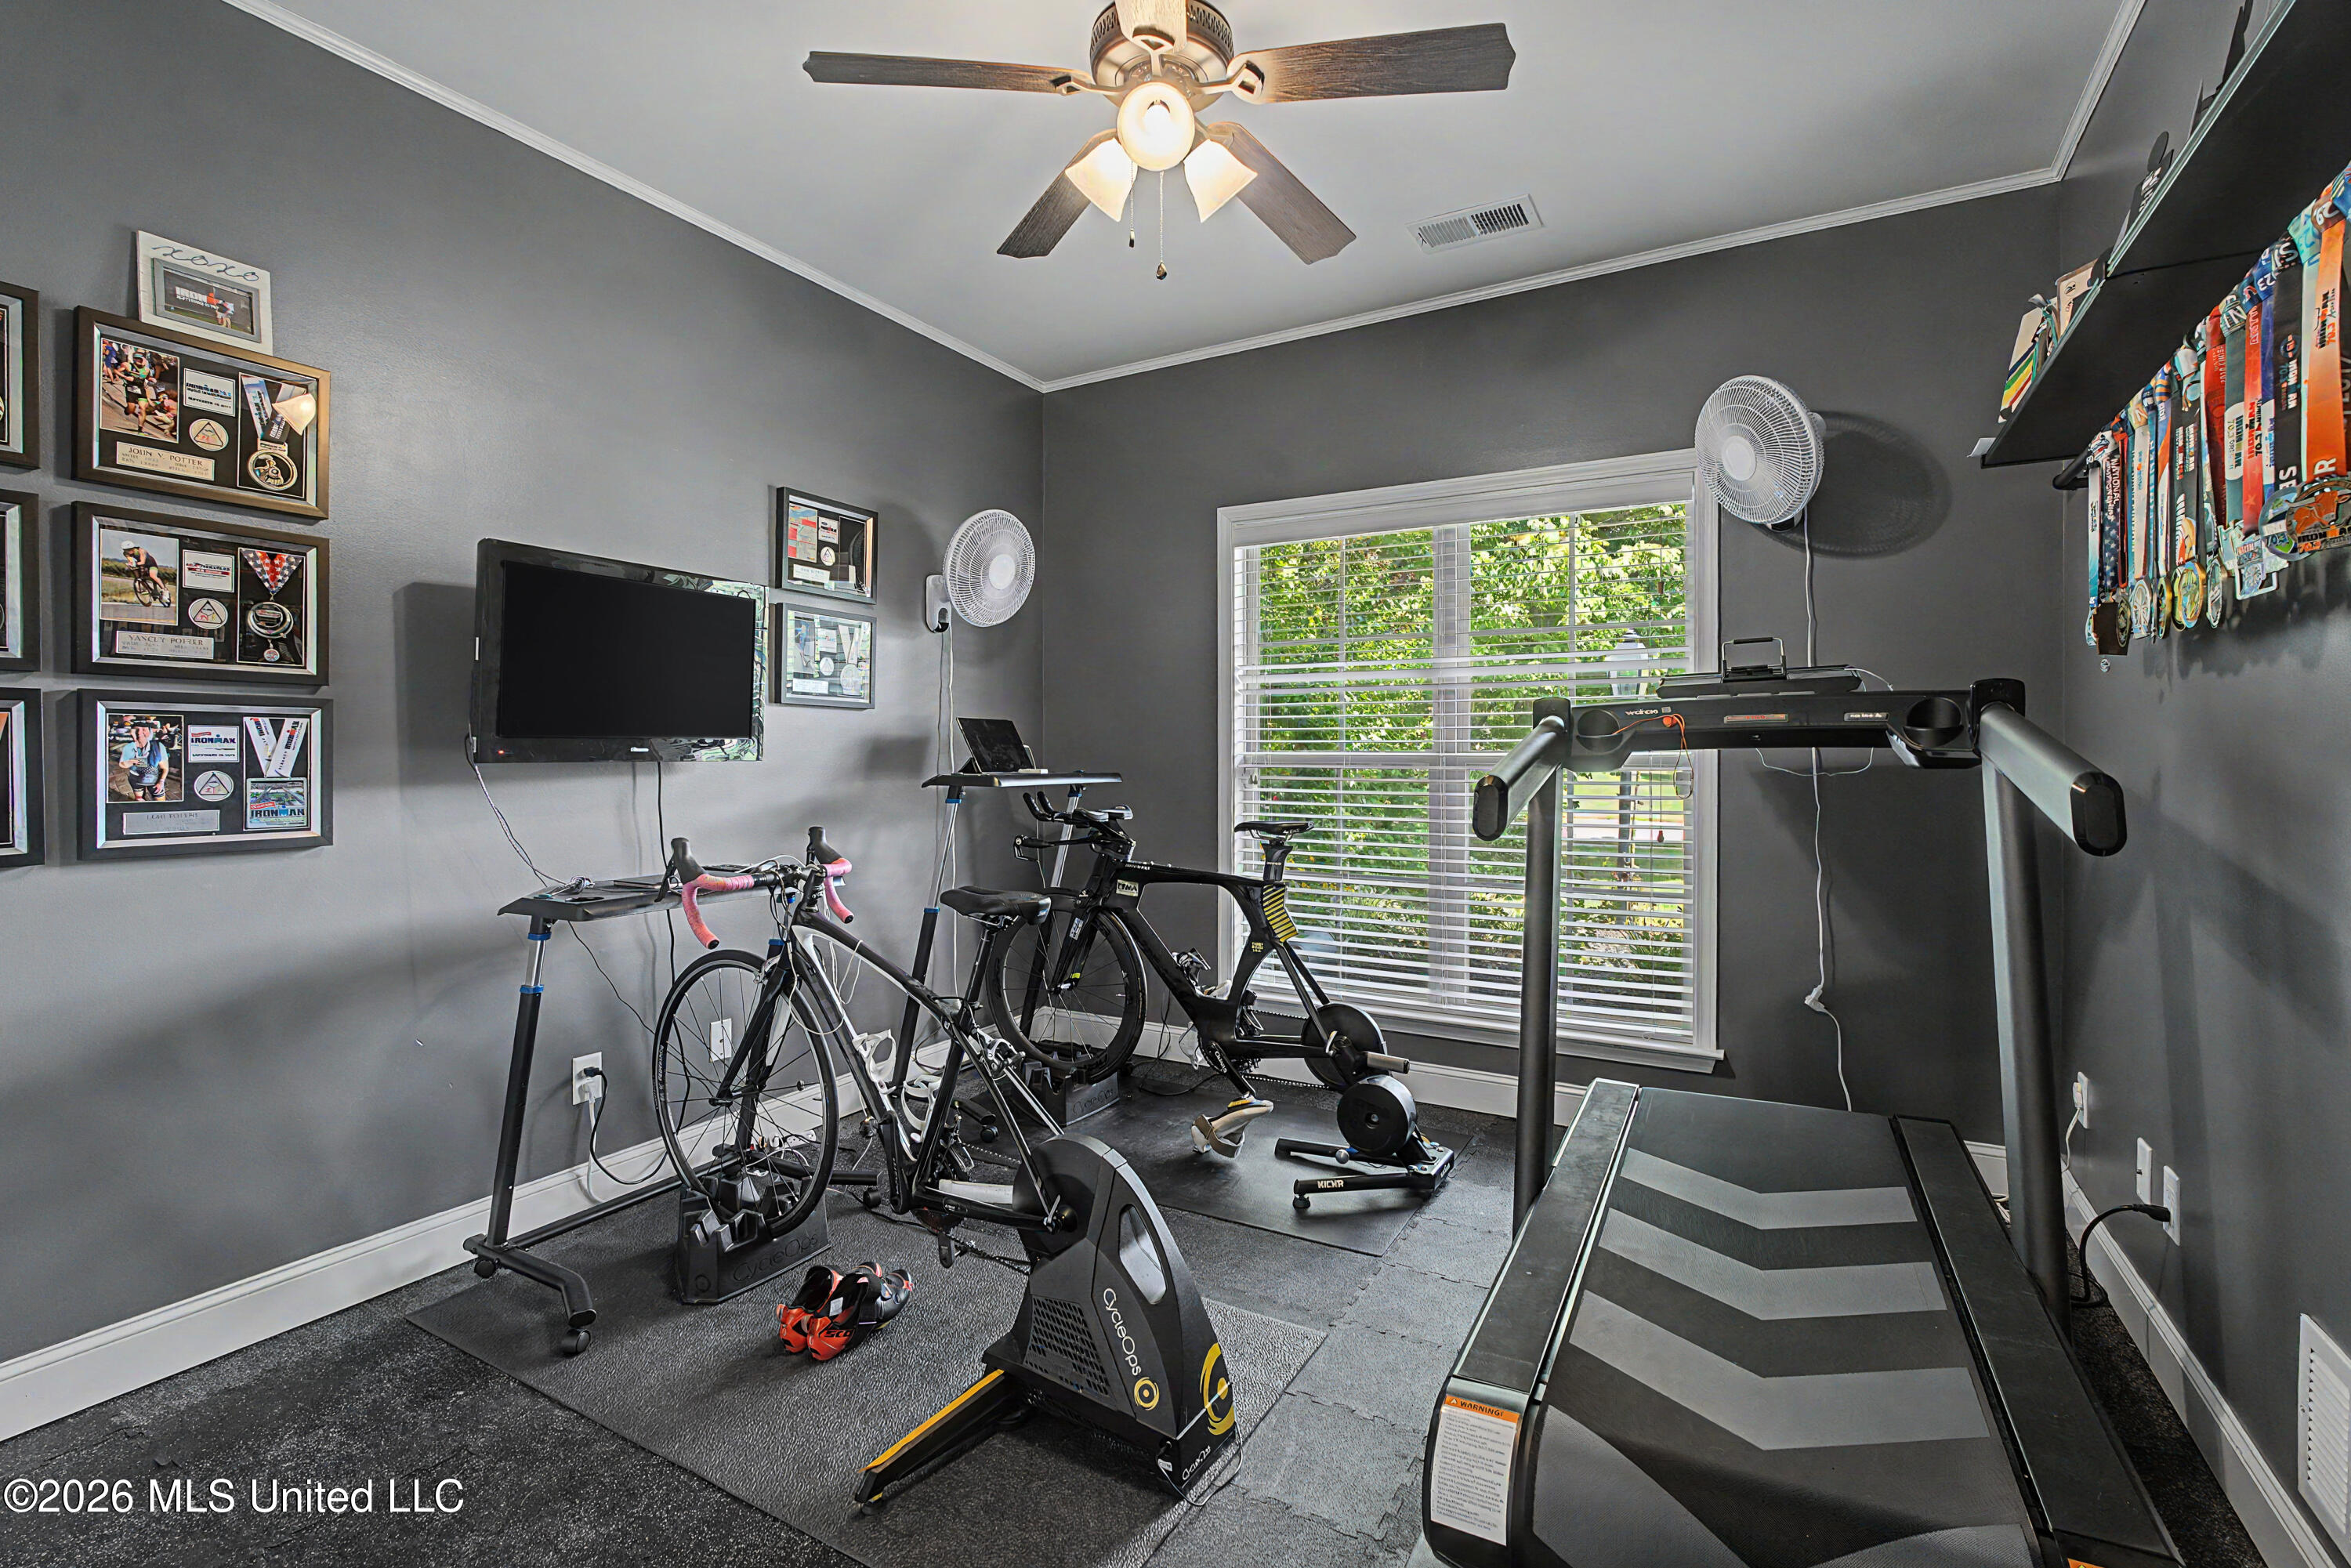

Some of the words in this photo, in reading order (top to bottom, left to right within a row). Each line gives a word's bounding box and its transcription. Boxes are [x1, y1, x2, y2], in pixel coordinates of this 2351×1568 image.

[169, 454, 204, 466] POTTER
[2110, 458, 2121, 505] NATIONAL
[190, 734, 236, 744] IRONMAN
[251, 806, 305, 817] IRONMAN
[1317, 1179, 1344, 1189] KICKR
[1103, 1287, 1142, 1376] CycleOps
[1460, 1400, 1504, 1417] WARNING!
